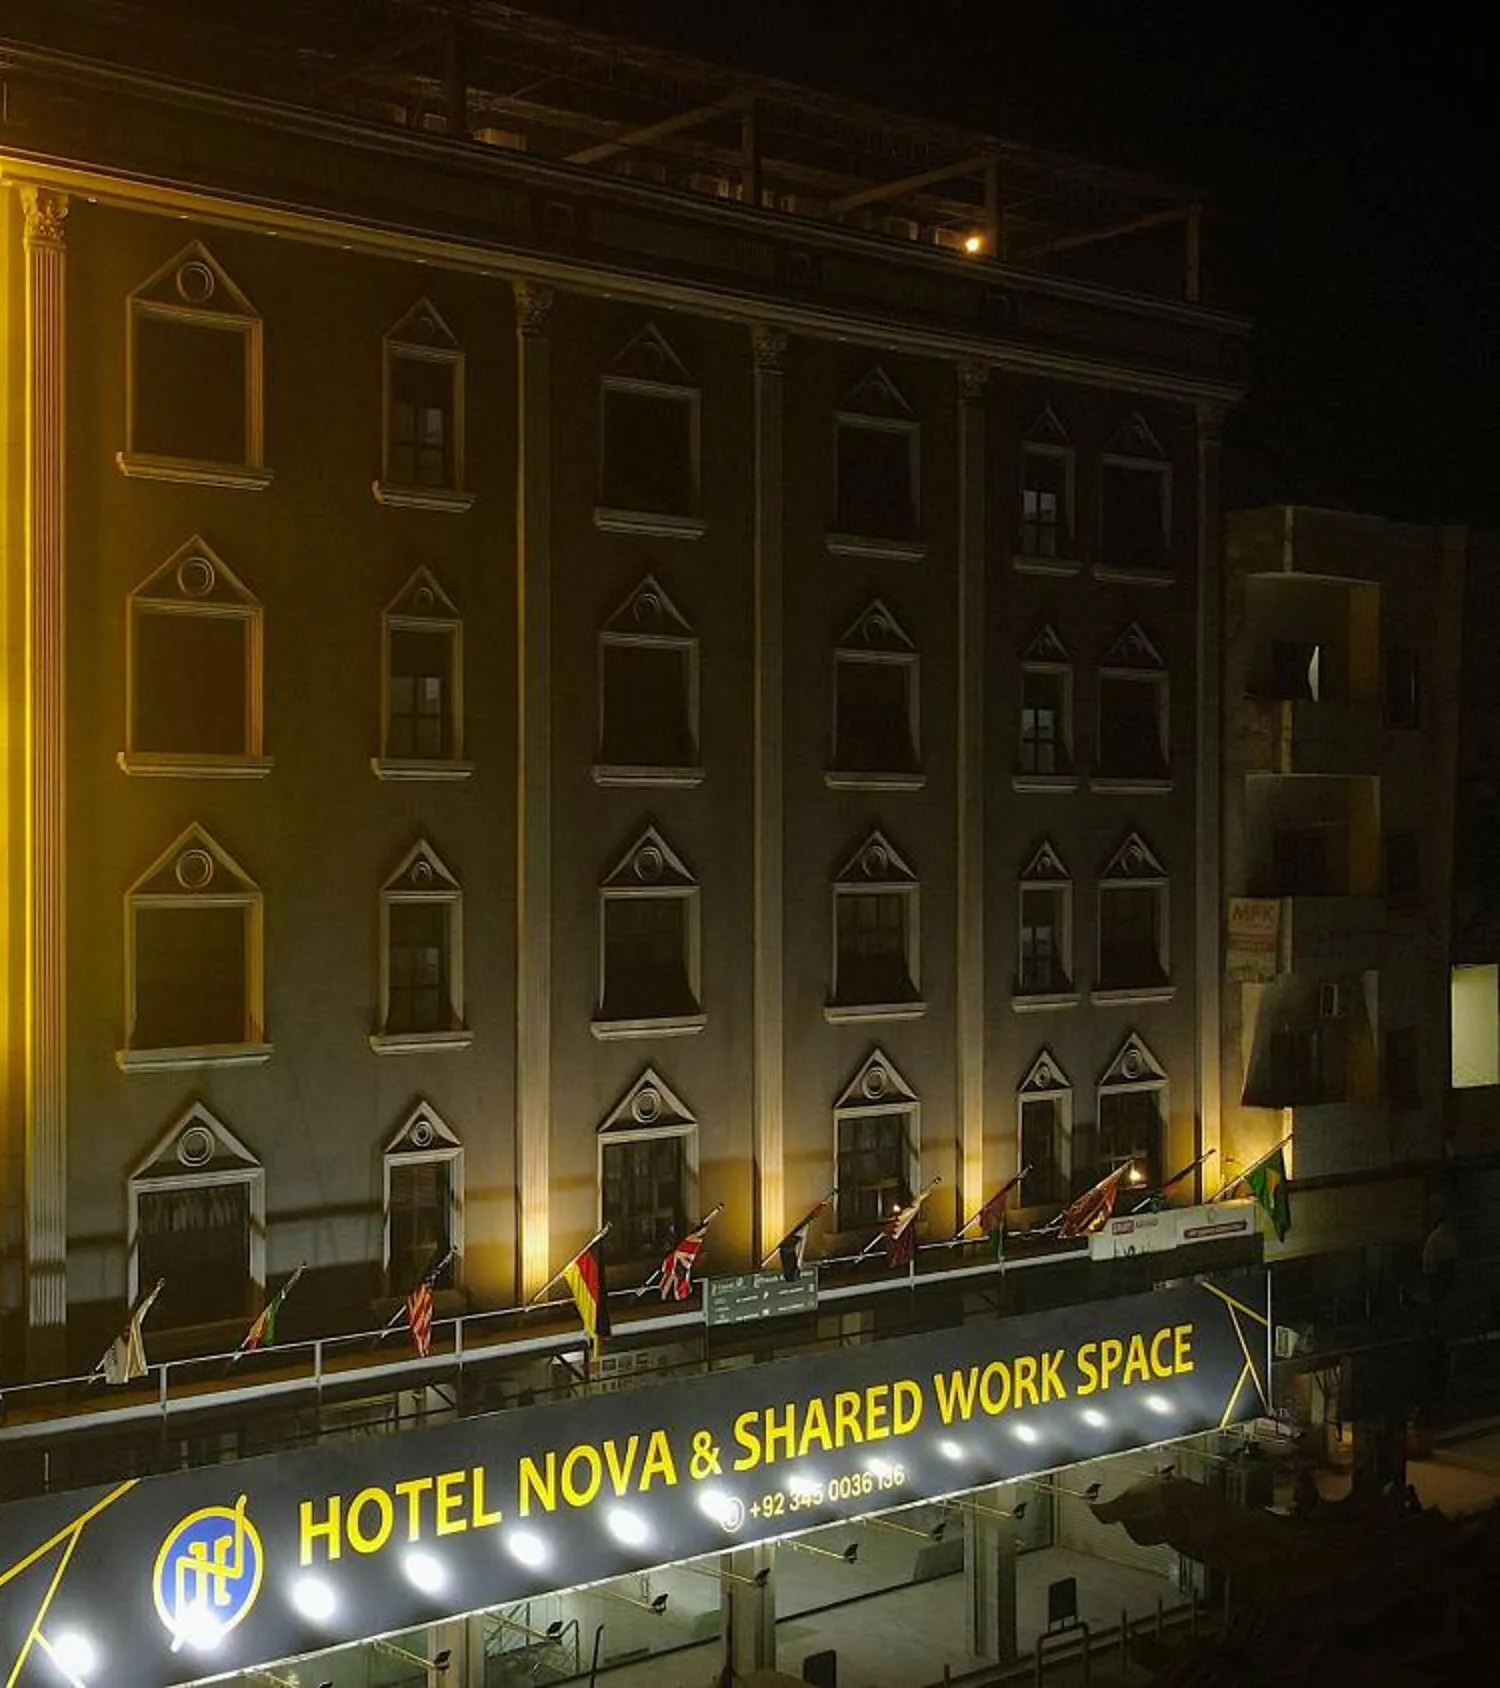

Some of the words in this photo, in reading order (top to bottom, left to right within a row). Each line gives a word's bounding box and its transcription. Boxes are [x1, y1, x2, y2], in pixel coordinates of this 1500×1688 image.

[299, 1467, 502, 1566] HOTEL
[518, 1430, 678, 1518] NOVA
[690, 1430, 723, 1480] &
[733, 1379, 923, 1472] SHARED
[934, 1349, 1066, 1425] WORK
[1076, 1324, 1194, 1396] SPACE
[749, 1492, 786, 1519] +92
[828, 1470, 873, 1501] 0036
